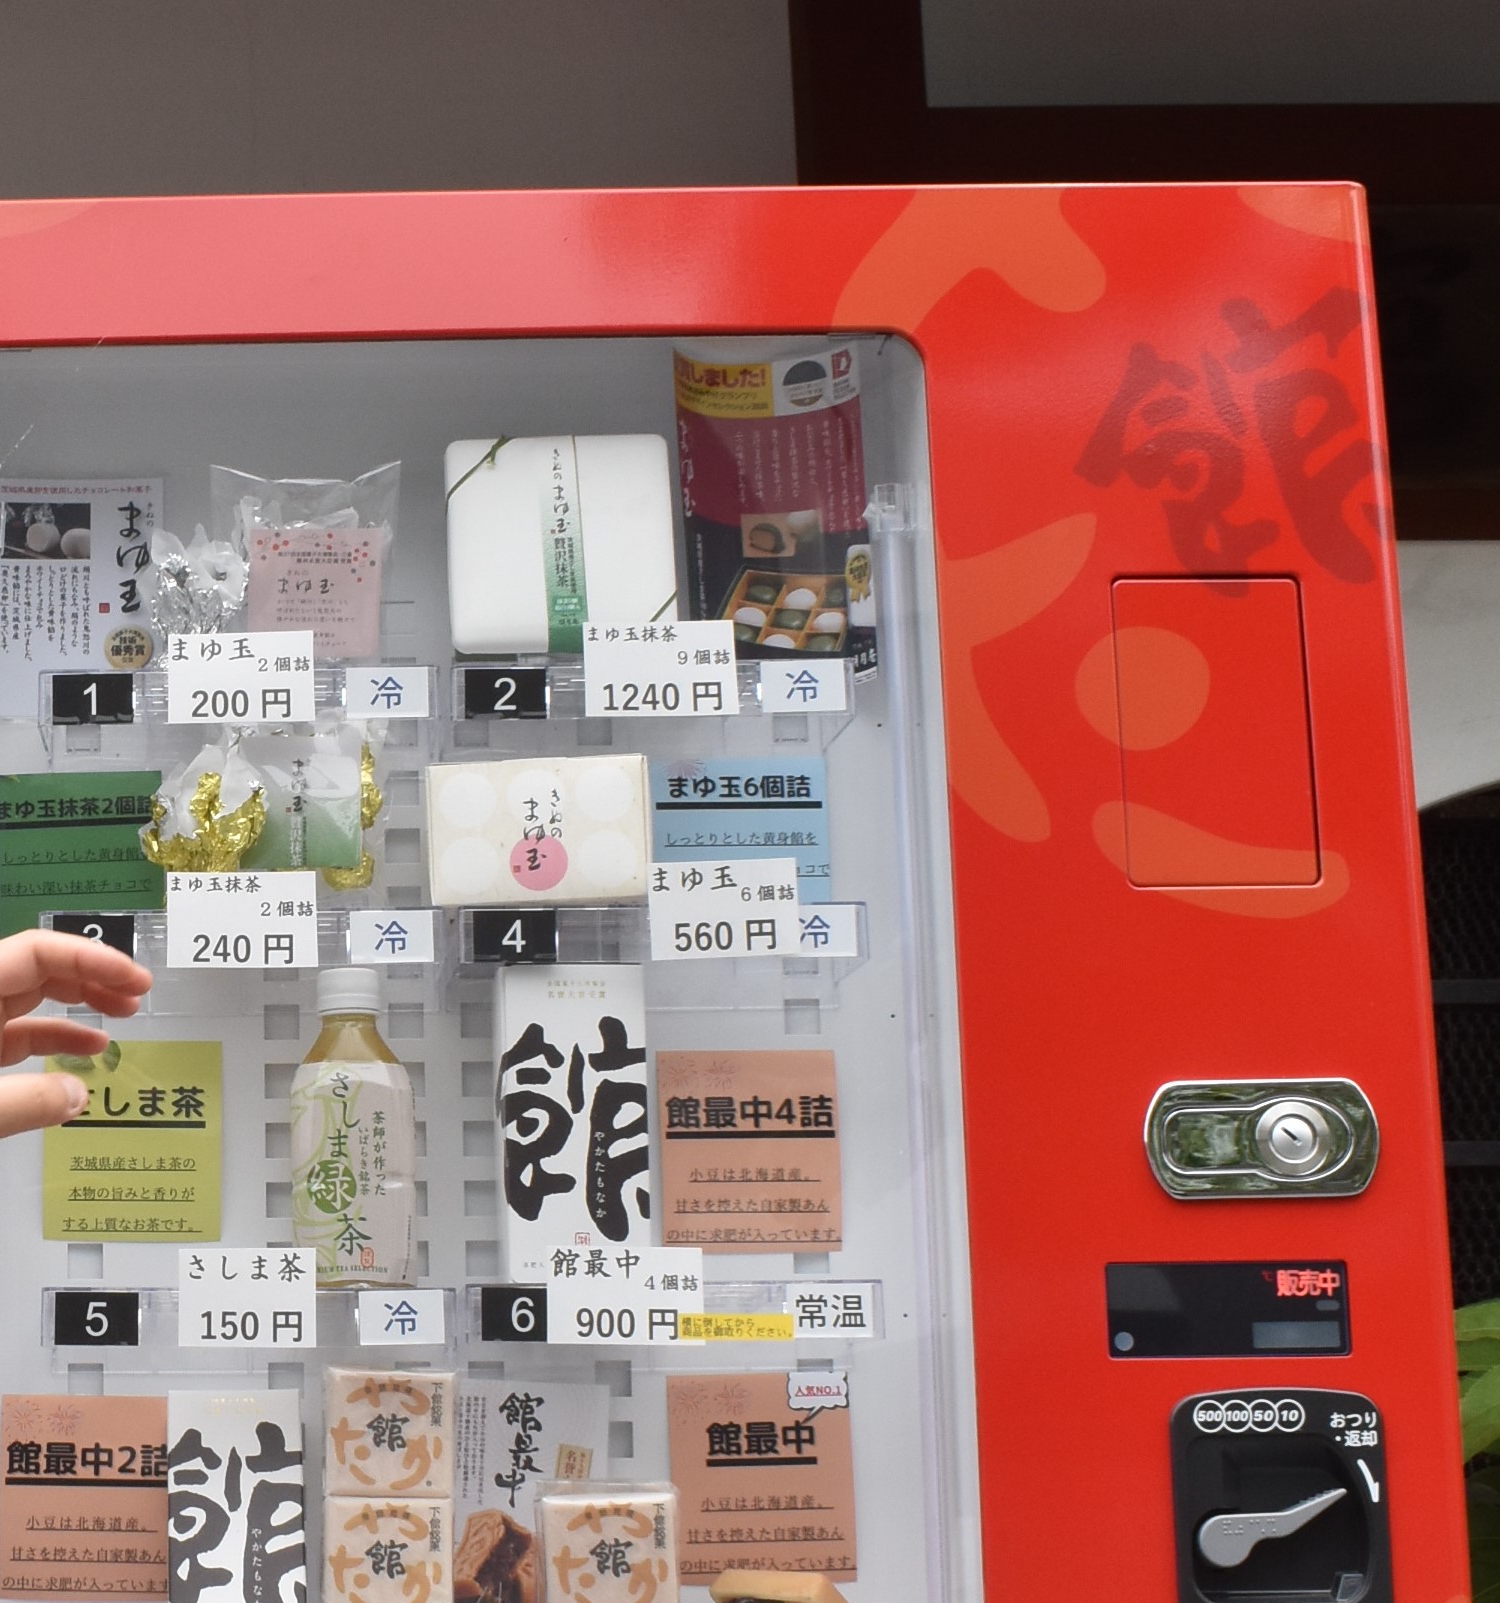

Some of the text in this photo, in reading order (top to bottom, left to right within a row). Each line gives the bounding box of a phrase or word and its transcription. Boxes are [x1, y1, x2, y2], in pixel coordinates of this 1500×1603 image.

[587, 626, 678, 643] まゆ玉抹茶
[171, 638, 311, 672] まゆ玉 2個詰
[677, 650, 730, 666] 9個詰
[83, 683, 98, 715] 1
[370, 676, 404, 709] 冷
[492, 677, 518, 711] 2
[785, 669, 819, 703] 冷
[668, 774, 812, 799] まゆ玉6個詰
[523, 797, 547, 872] まゆ玉
[665, 831, 819, 847] しっとりとした黄身餡を
[169, 875, 262, 893] まゆ玉抹茶
[652, 865, 795, 902] まゆ玉 6個詰
[260, 901, 315, 918] 2個詰
[373, 920, 409, 954] 冷
[502, 919, 526, 953] 4
[800, 914, 831, 949] 冷
[666, 1095, 834, 1129] 館最中4詰
[68, 1155, 197, 1171] 茨城県産さしま茶の
[371, 1110, 387, 1197] 茶師が作った
[593, 1131, 607, 1219] やかたもなか
[689, 1167, 811, 1182] 小豆は北海道産。
[67, 1185, 196, 1201] 本物の旨みと香りが
[675, 1198, 831, 1213] 甘さを控えた自家製あん
[62, 1217, 197, 1232] する上質なお茶です。
[666, 1228, 843, 1242] の中に求肥が入っています。
[188, 1253, 307, 1283] さしま茶
[550, 1249, 699, 1292] 館最中 4個詰
[1276, 1268, 1341, 1297] 販売中
[85, 1301, 109, 1338] 5
[383, 1300, 419, 1336] 冷
[511, 1297, 536, 1333] 6
[795, 1294, 867, 1330] 常温
[1197, 1409, 1300, 1422] 500 100 50 10
[1329, 1411, 1378, 1429] おつり
[366, 1413, 411, 1452] 館
[705, 1419, 816, 1456] 館最中
[6, 1441, 168, 1477] 館最中2詰
[495, 1391, 545, 1509] 館最中
[701, 1494, 824, 1512] 小豆は北海道産。
[26, 1515, 148, 1531] 小豆は北海道産。
[688, 1525, 844, 1543] 甘さを控えた自家製あん
[11, 1546, 167, 1563] 甘さを控えた自家製あん
[365, 1539, 409, 1580] 館
[589, 1538, 634, 1578] 館
